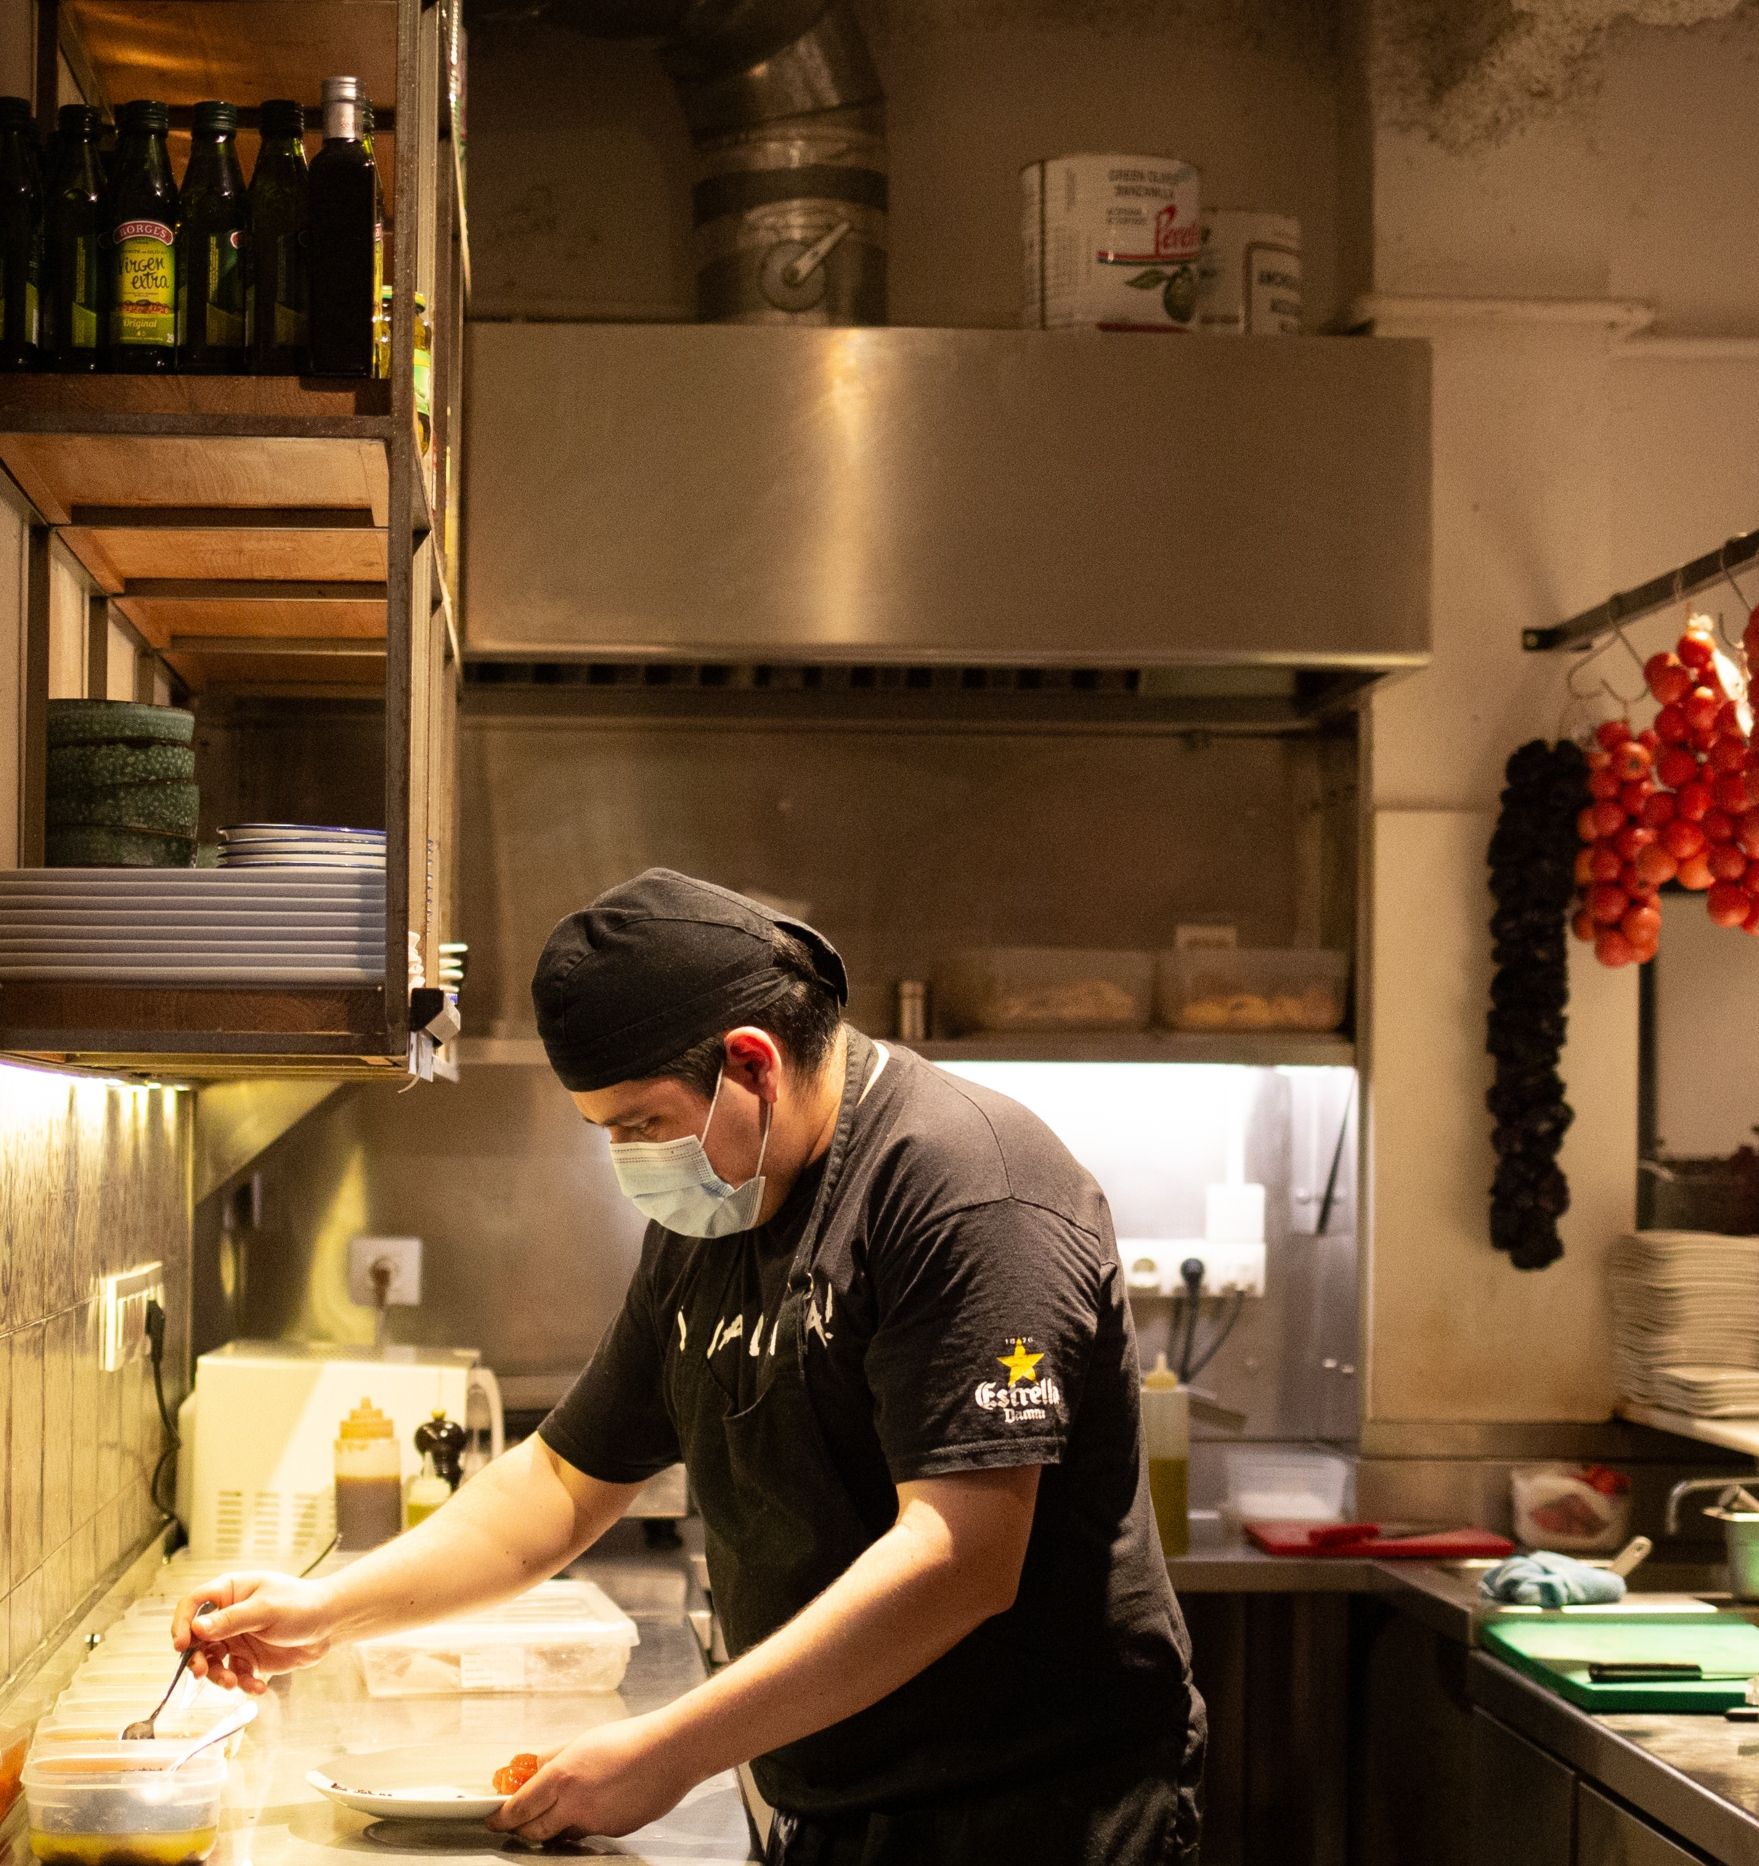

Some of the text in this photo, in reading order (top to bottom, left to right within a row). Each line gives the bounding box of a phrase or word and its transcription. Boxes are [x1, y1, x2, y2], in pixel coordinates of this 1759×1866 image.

[120, 224, 167, 239] BORGES
[132, 271, 170, 289] extra
[122, 318, 158, 330] Original
[1003, 1407, 1047, 1424] Damm
